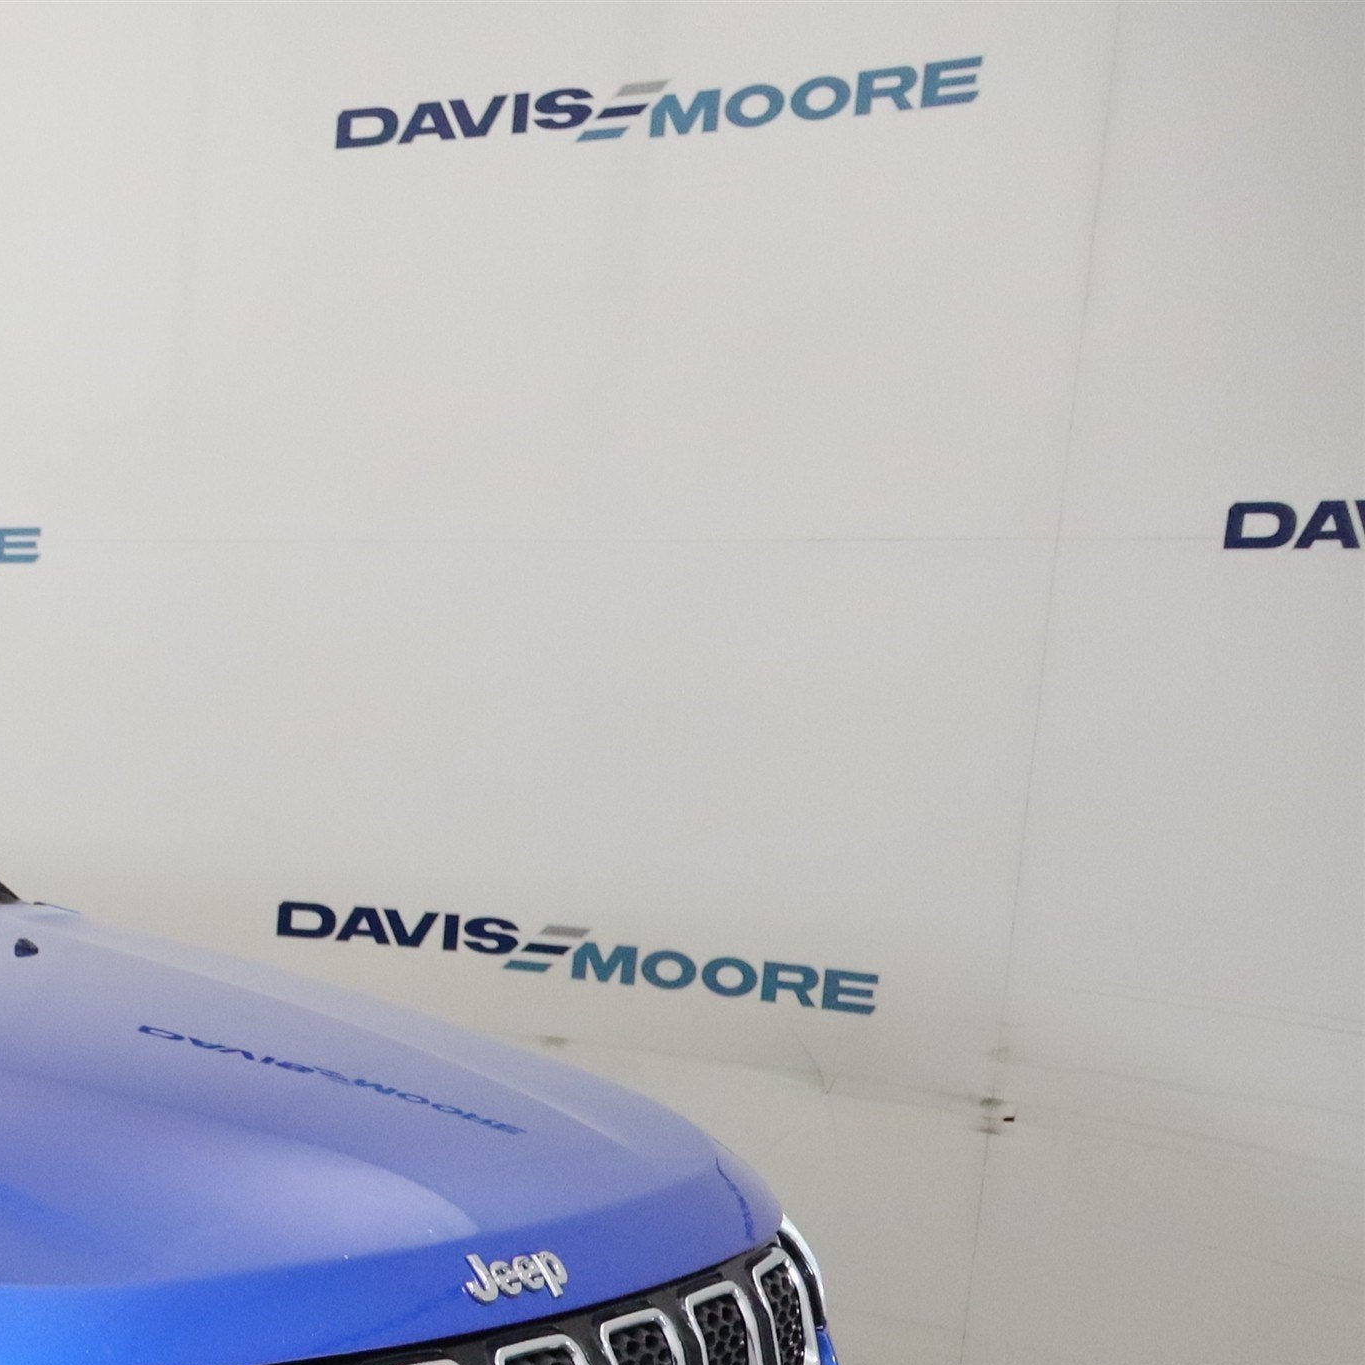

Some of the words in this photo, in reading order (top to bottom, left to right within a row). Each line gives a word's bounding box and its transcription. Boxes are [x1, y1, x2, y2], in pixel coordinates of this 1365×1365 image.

[649, 56, 983, 138] MOORE
[1223, 499, 1365, 550] DA
[571, 942, 880, 1016] MOORE
[463, 1250, 569, 1303] Jeep
